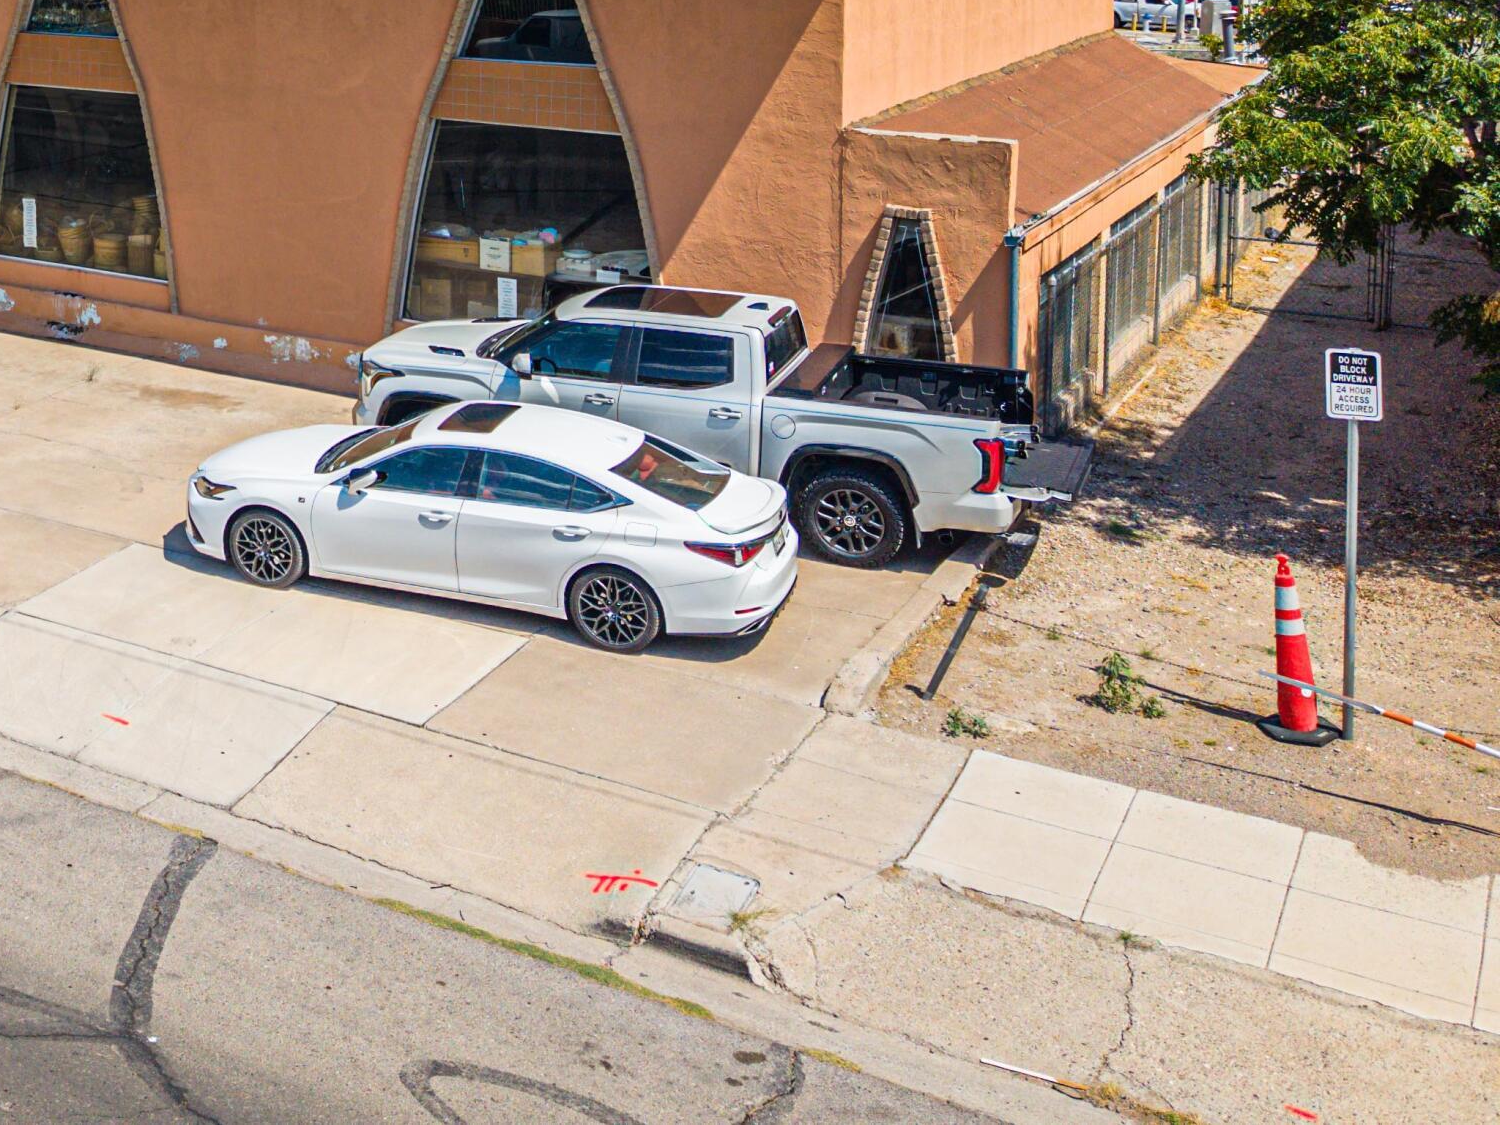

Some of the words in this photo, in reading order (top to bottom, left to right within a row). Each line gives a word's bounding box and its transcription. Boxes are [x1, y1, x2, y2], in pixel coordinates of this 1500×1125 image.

[1338, 356, 1350, 365] DO
[1352, 357, 1368, 365] NOT
[1340, 365, 1367, 374] BLOCK
[1332, 374, 1374, 384] DRIVEWAY
[1349, 387, 1371, 395] HOUR
[1338, 395, 1370, 404] ACCESS
[1334, 403, 1374, 413] REQUIRED
